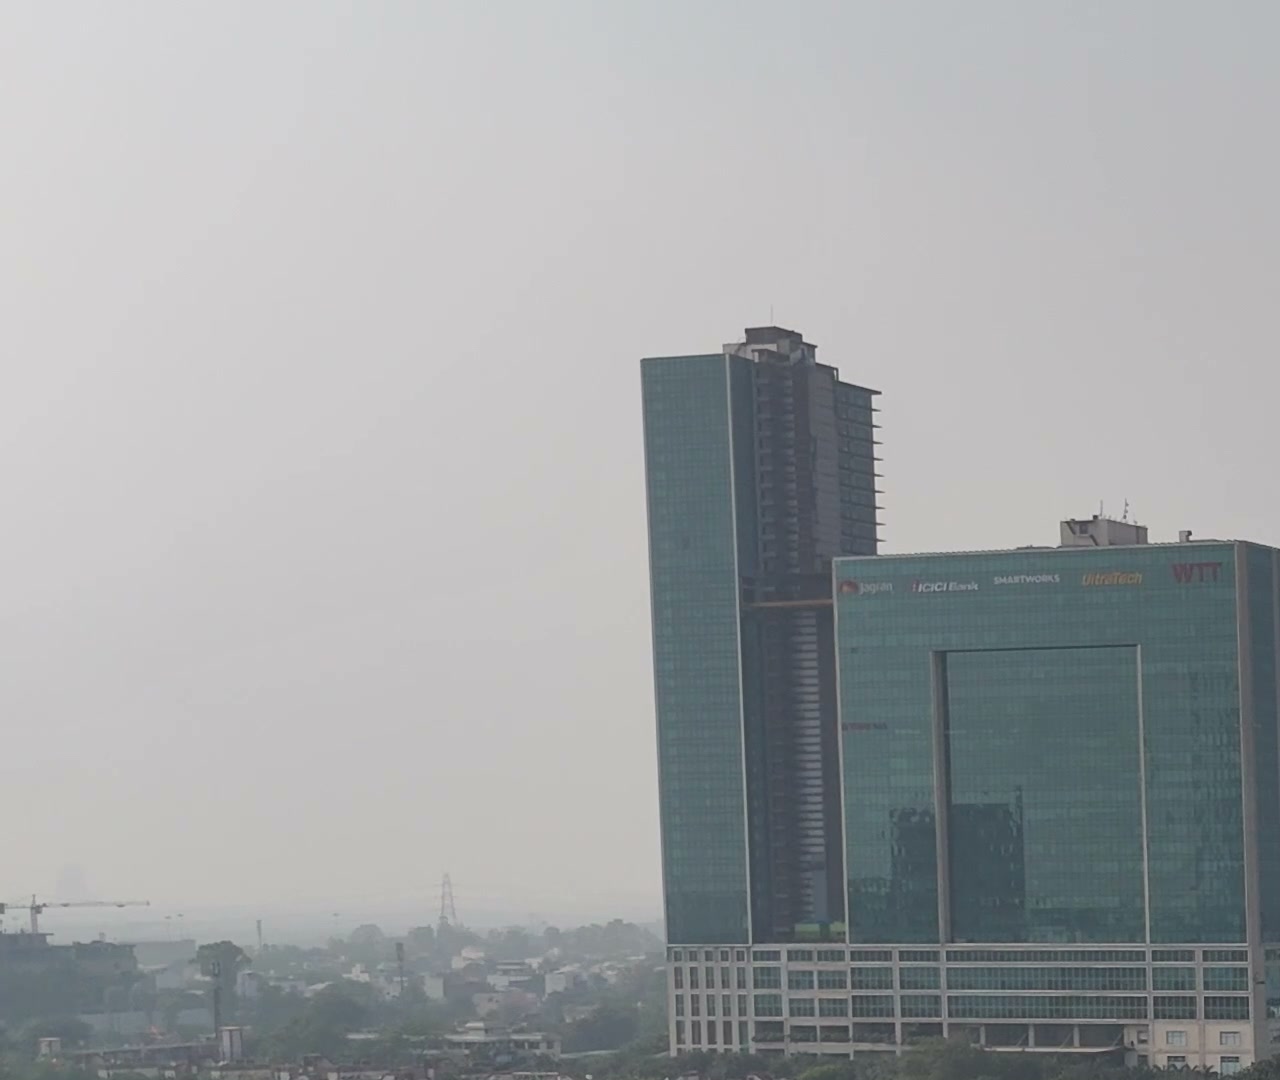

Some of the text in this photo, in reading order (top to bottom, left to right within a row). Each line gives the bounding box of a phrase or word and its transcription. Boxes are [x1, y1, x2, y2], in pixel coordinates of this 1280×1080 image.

[994, 574, 1060, 585] SMARTWORKS
[917, 581, 979, 593] ICICI Bank
